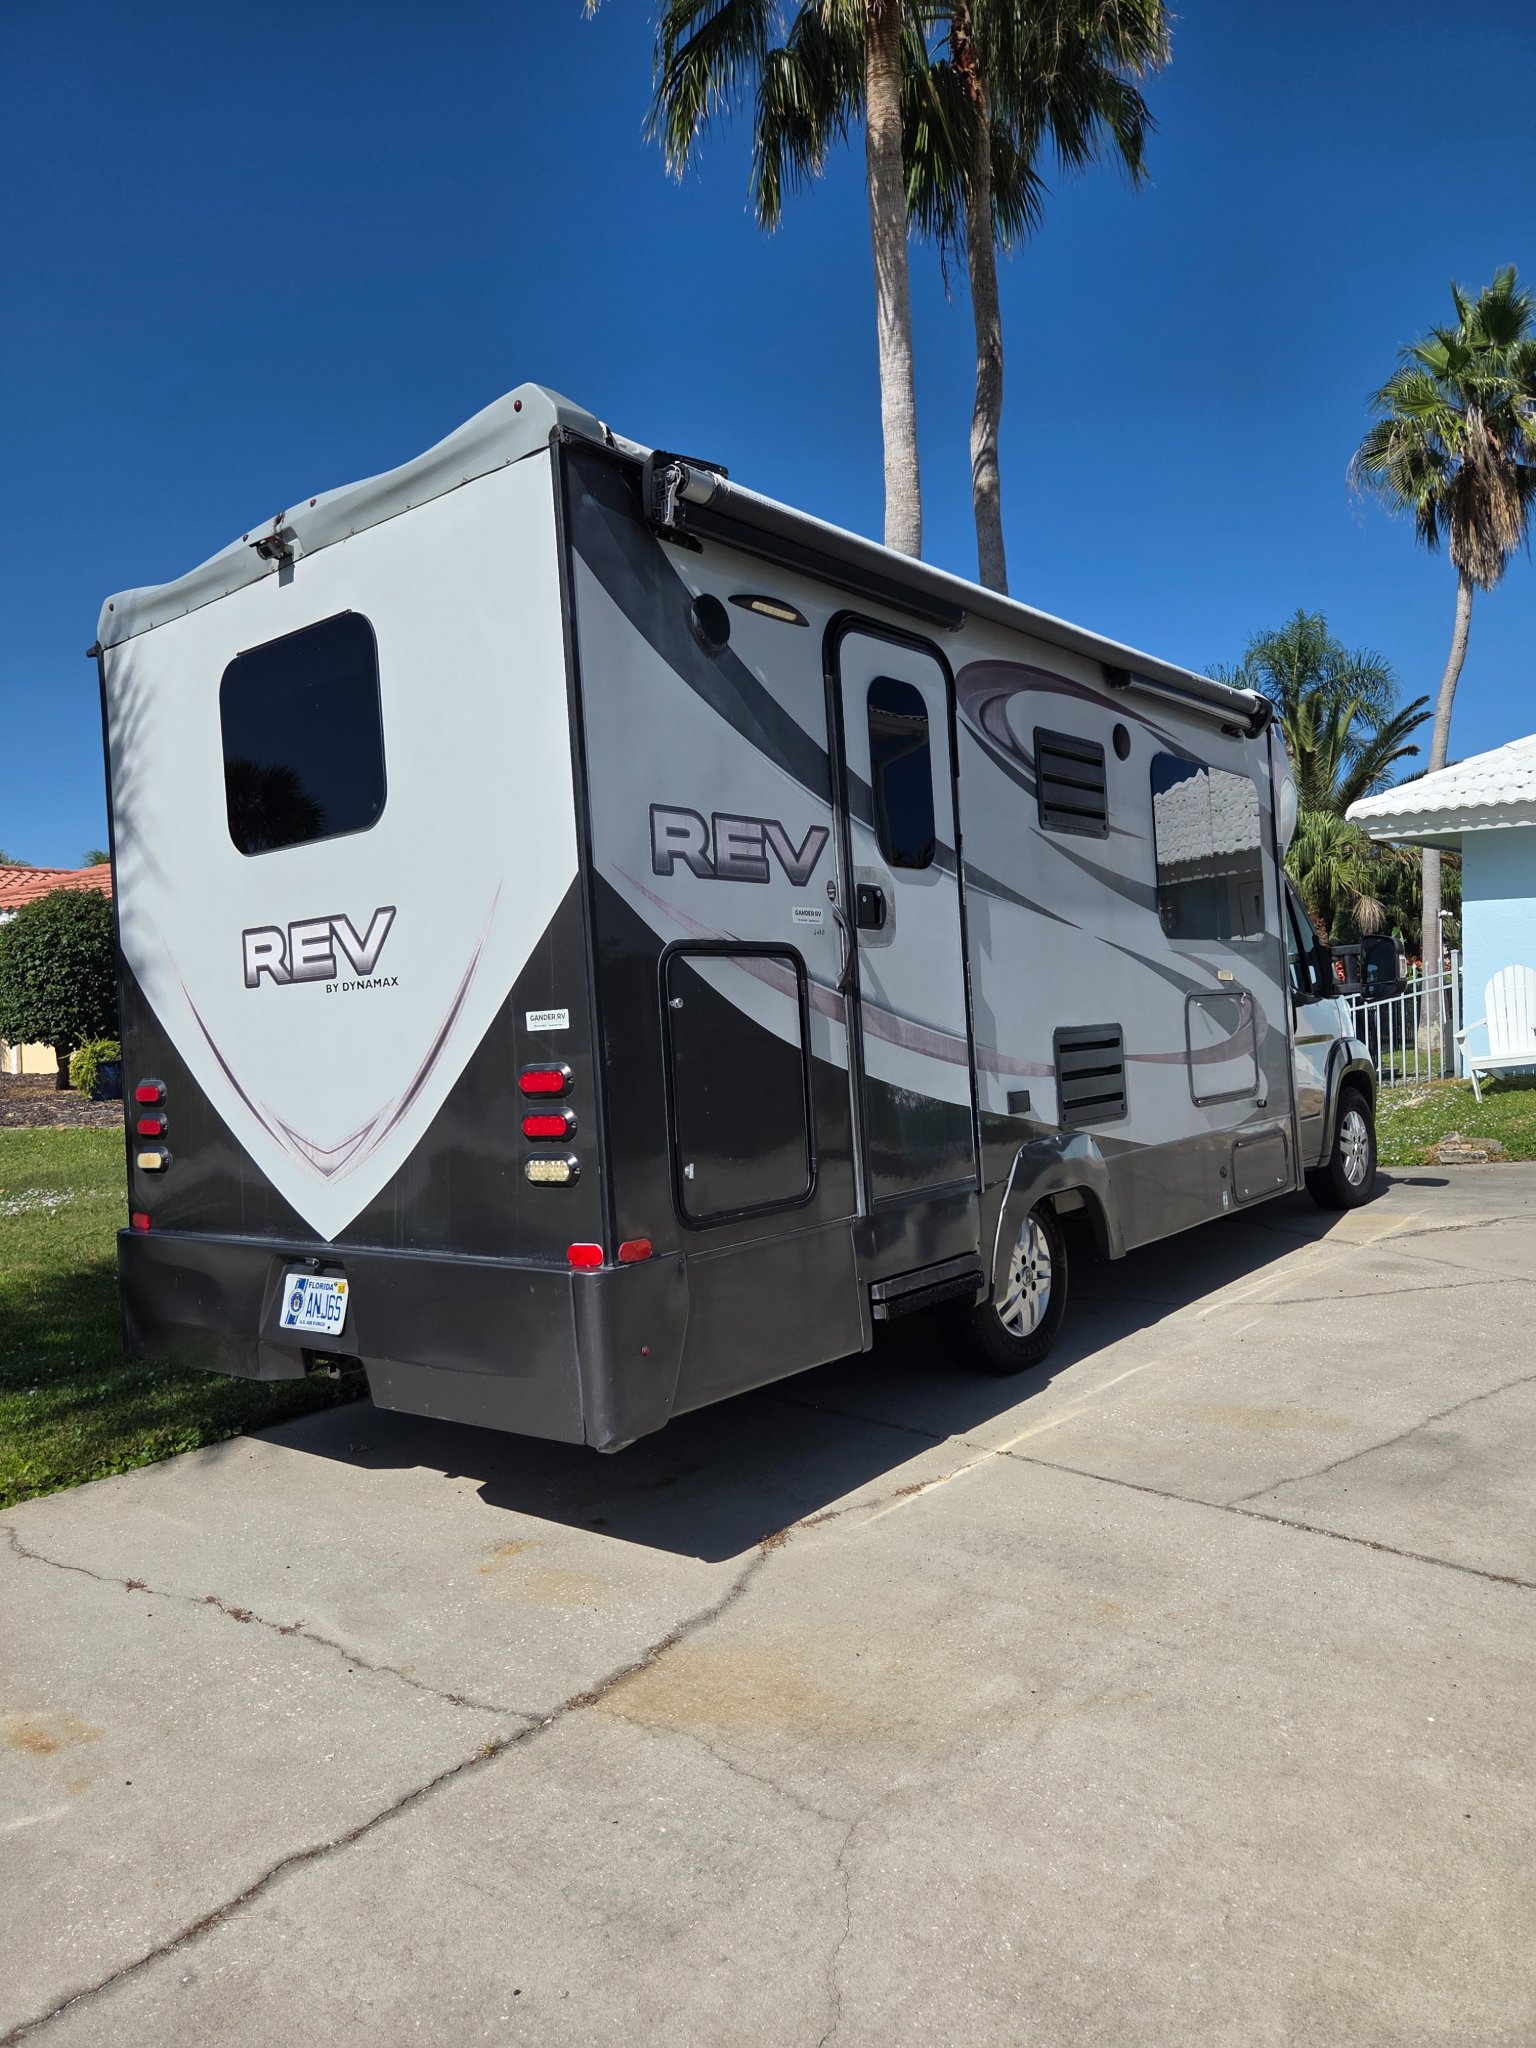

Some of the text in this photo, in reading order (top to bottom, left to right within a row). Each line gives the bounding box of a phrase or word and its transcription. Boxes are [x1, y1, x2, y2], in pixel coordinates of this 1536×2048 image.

[649, 803, 830, 887] REV
[242, 905, 397, 989] REV
[326, 977, 399, 993] BY DYNAMAX
[530, 1013, 556, 1021] GANDER
[308, 1281, 334, 1291] FLORIDA
